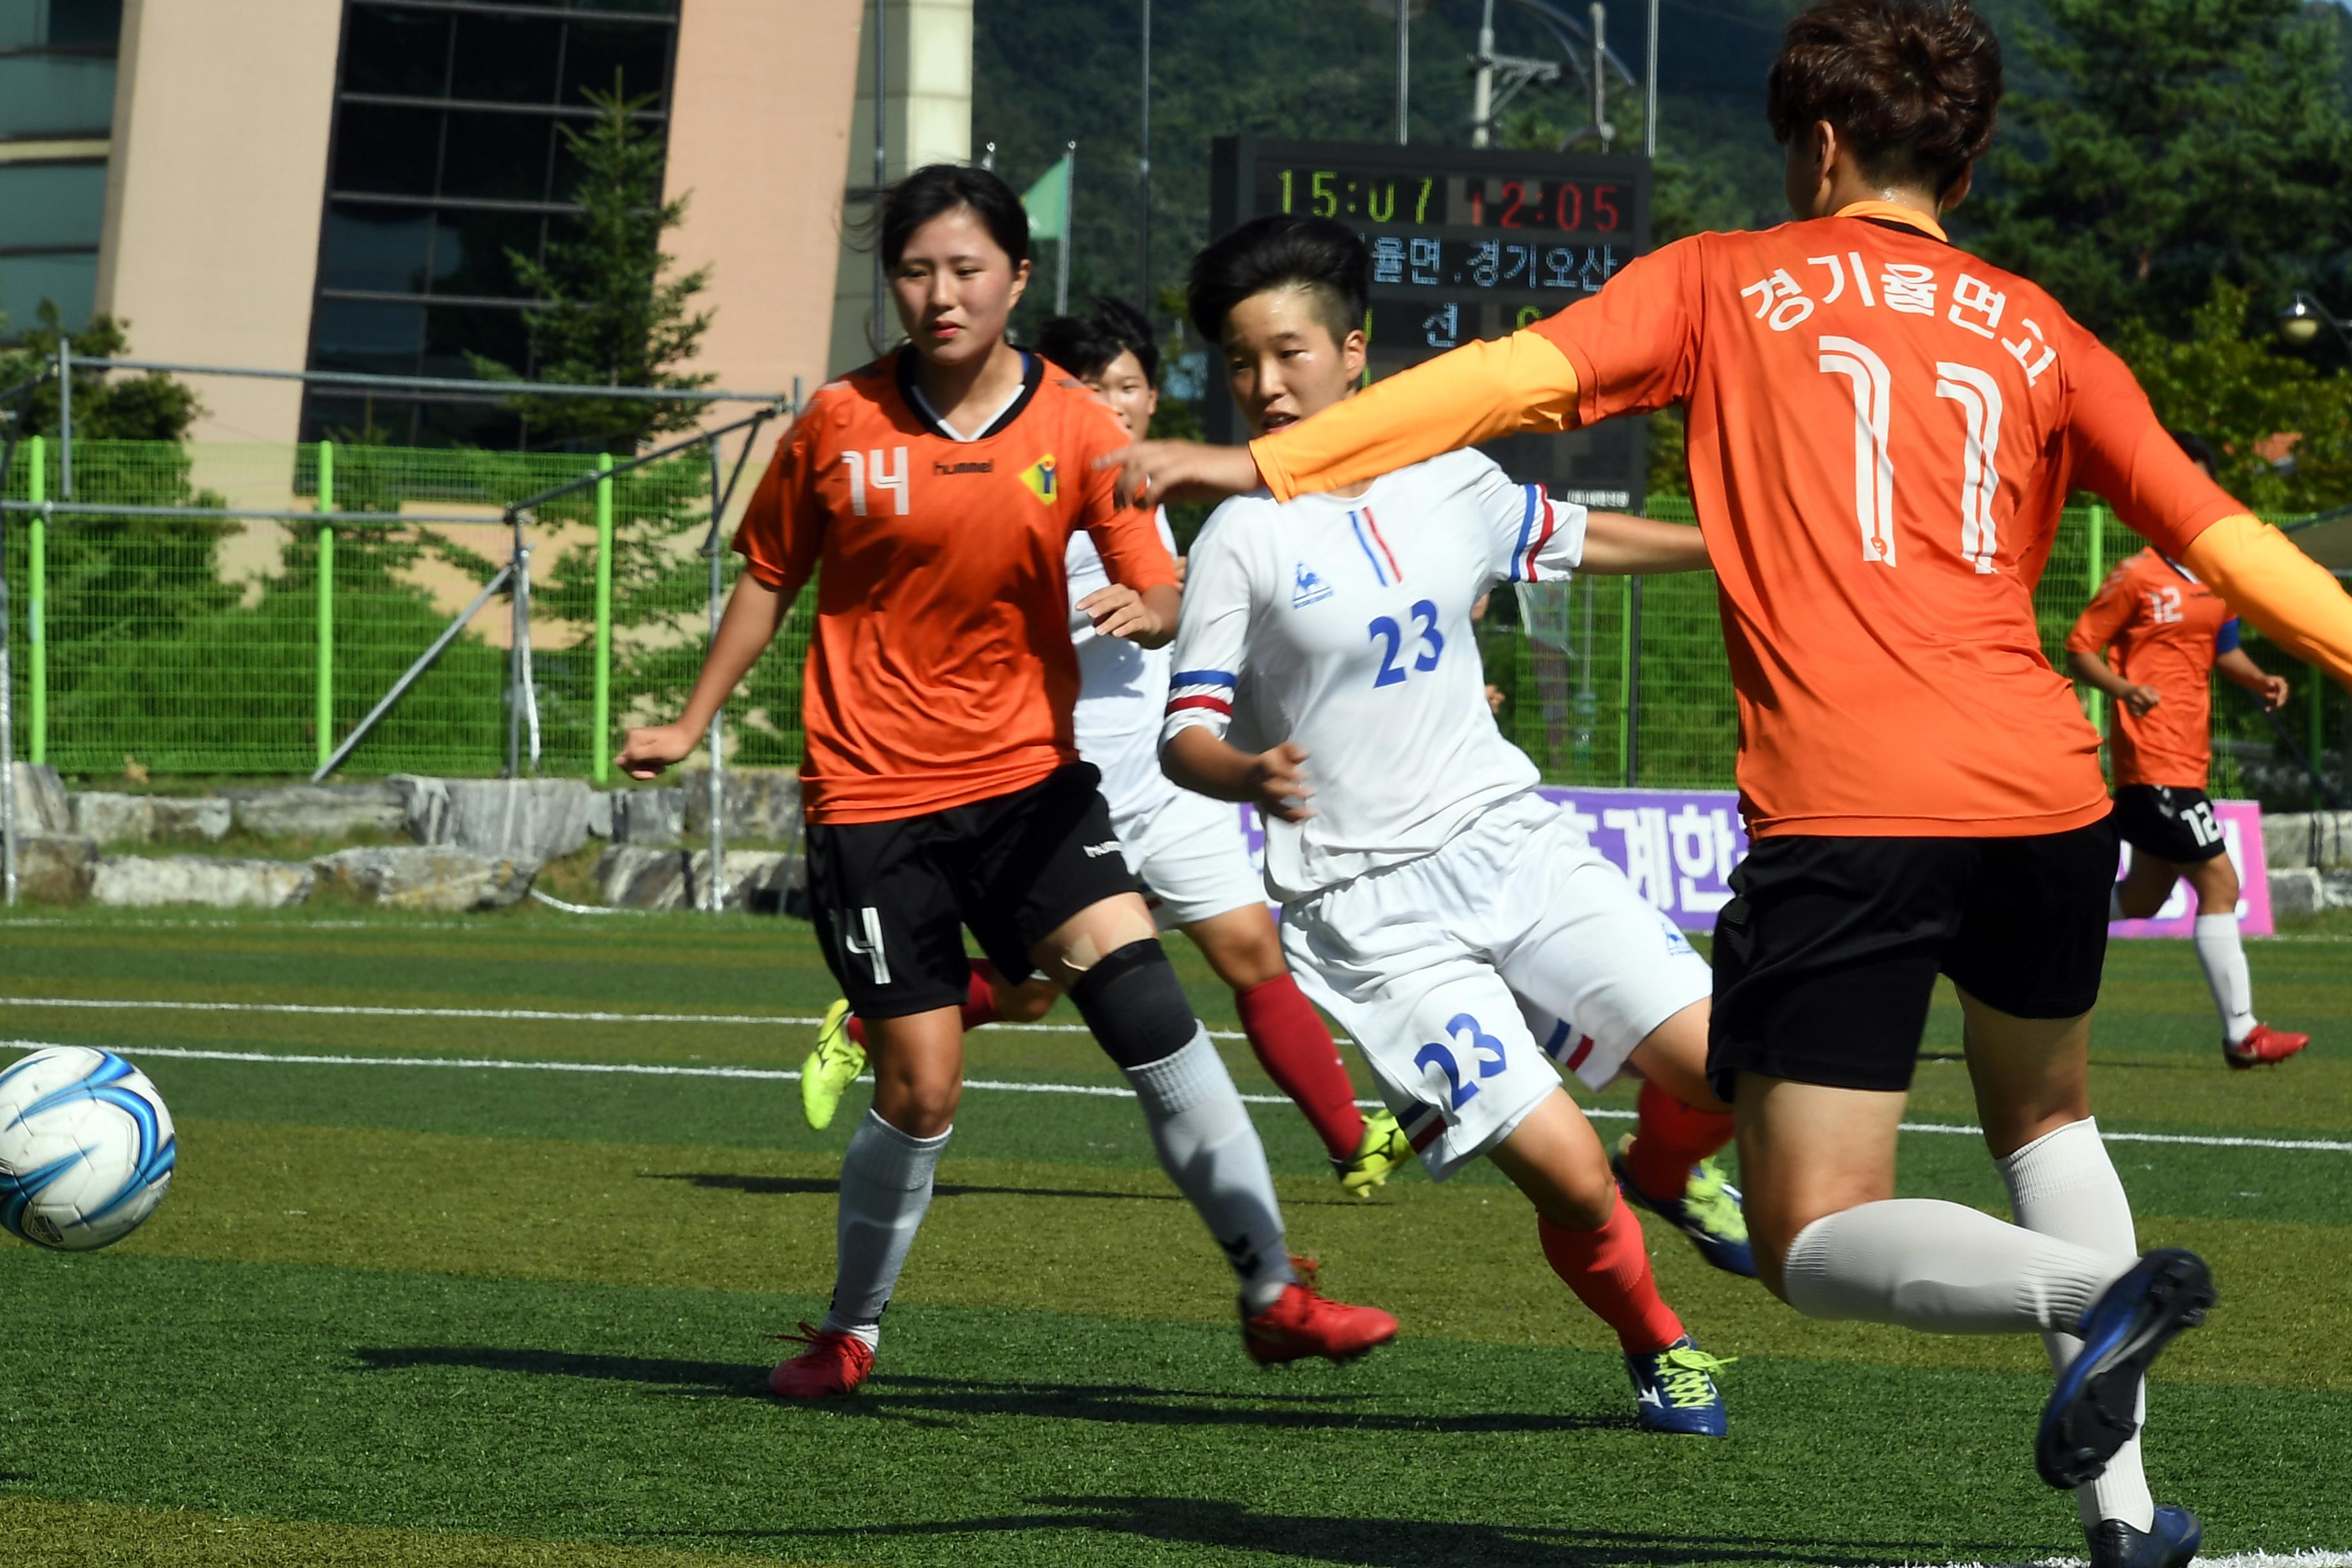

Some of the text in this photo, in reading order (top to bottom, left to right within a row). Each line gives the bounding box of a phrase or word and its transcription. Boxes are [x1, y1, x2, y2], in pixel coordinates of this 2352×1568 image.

[1279, 169, 1620, 232] 15:07 12:05
[1740, 251, 2057, 387] 경기율면고
[841, 446, 909, 516] 14
[2147, 585, 2184, 624] 12
[1367, 600, 1444, 689] 23
[1560, 799, 1749, 912] 계한
[2179, 801, 2220, 847] 12
[1414, 1013, 1507, 1110] 23
